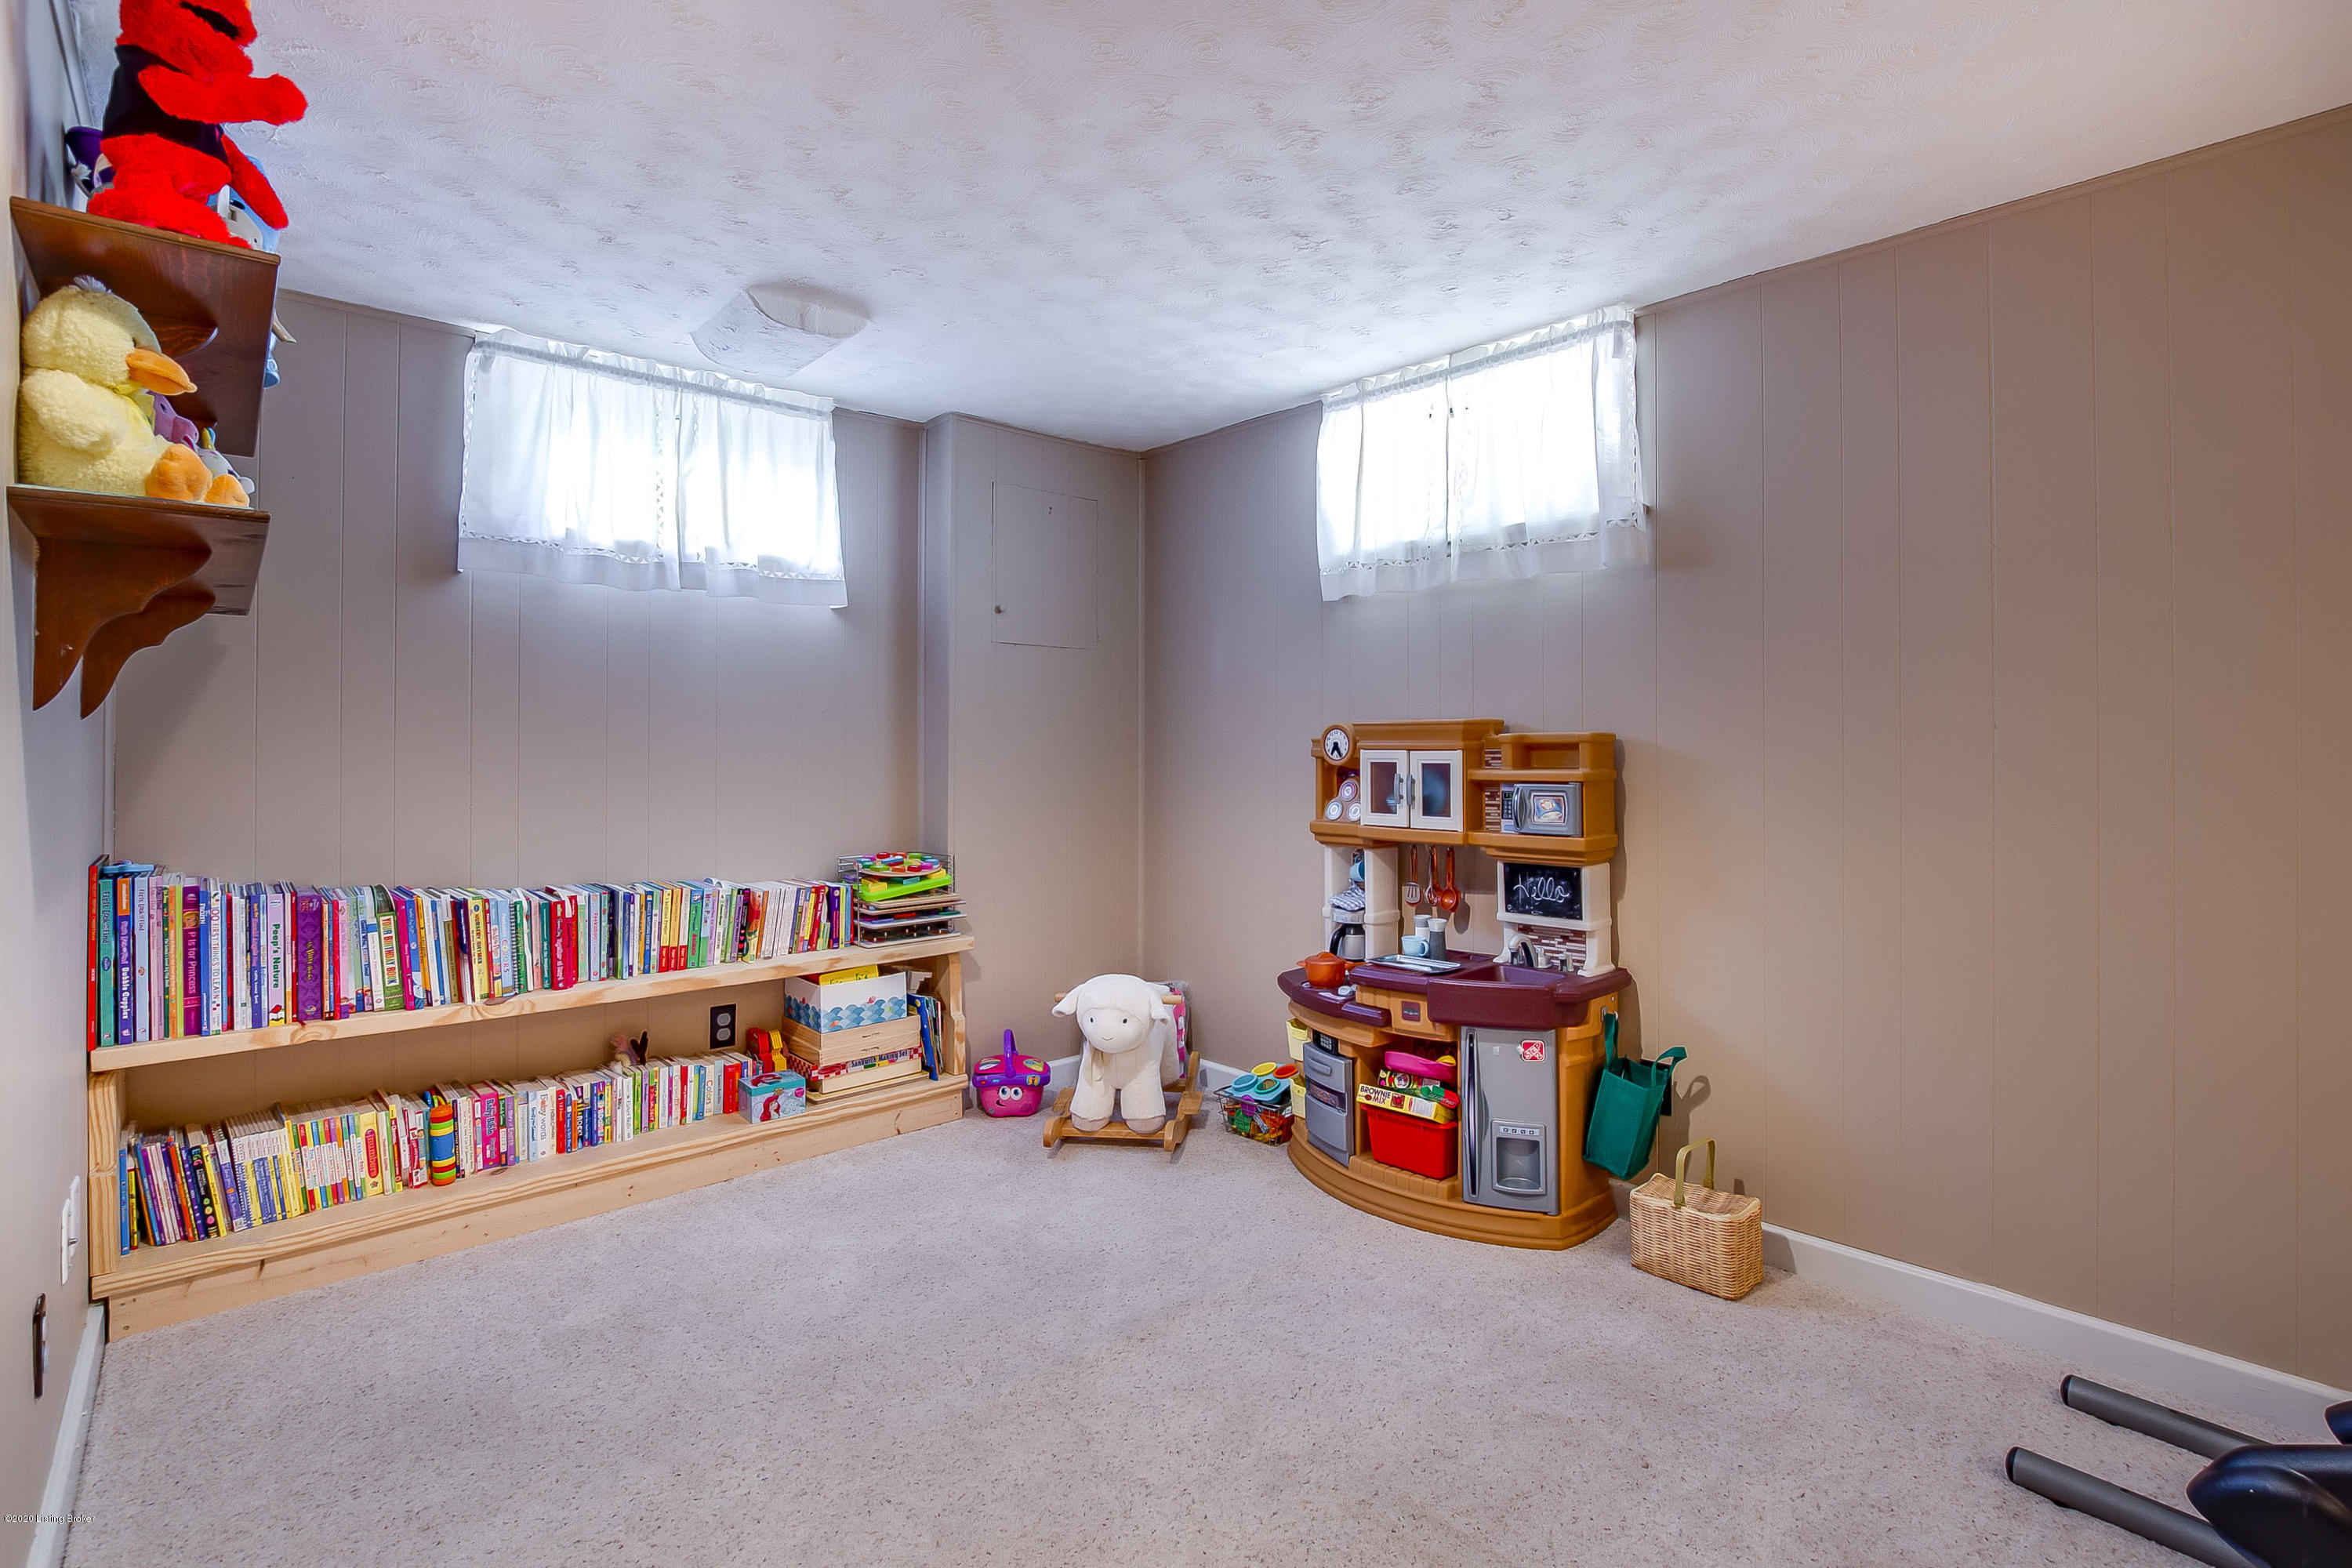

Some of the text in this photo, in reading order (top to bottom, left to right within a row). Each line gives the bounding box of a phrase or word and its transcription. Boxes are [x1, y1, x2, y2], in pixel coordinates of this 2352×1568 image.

[1513, 873, 1570, 903] Hello
[270, 924, 281, 953] Peep's
[382, 917, 397, 985] YOUR BIRTHDAY BOOK
[189, 960, 198, 993] Princess
[212, 968, 220, 977] TO
[120, 967, 130, 1019] Bubble Guppies
[851, 1049, 909, 1068] Sandwich Making Set
[1524, 1043, 1540, 1059] STEP
[1360, 1085, 1392, 1099] BROWNIE
[1372, 1094, 1386, 1105] MIX
[485, 1098, 495, 1116] Baby
[539, 1094, 548, 1116] baby
[486, 1117, 496, 1135] Bible
[192, 1148, 202, 1167] EGG
[367, 1137, 378, 1177] numbers
